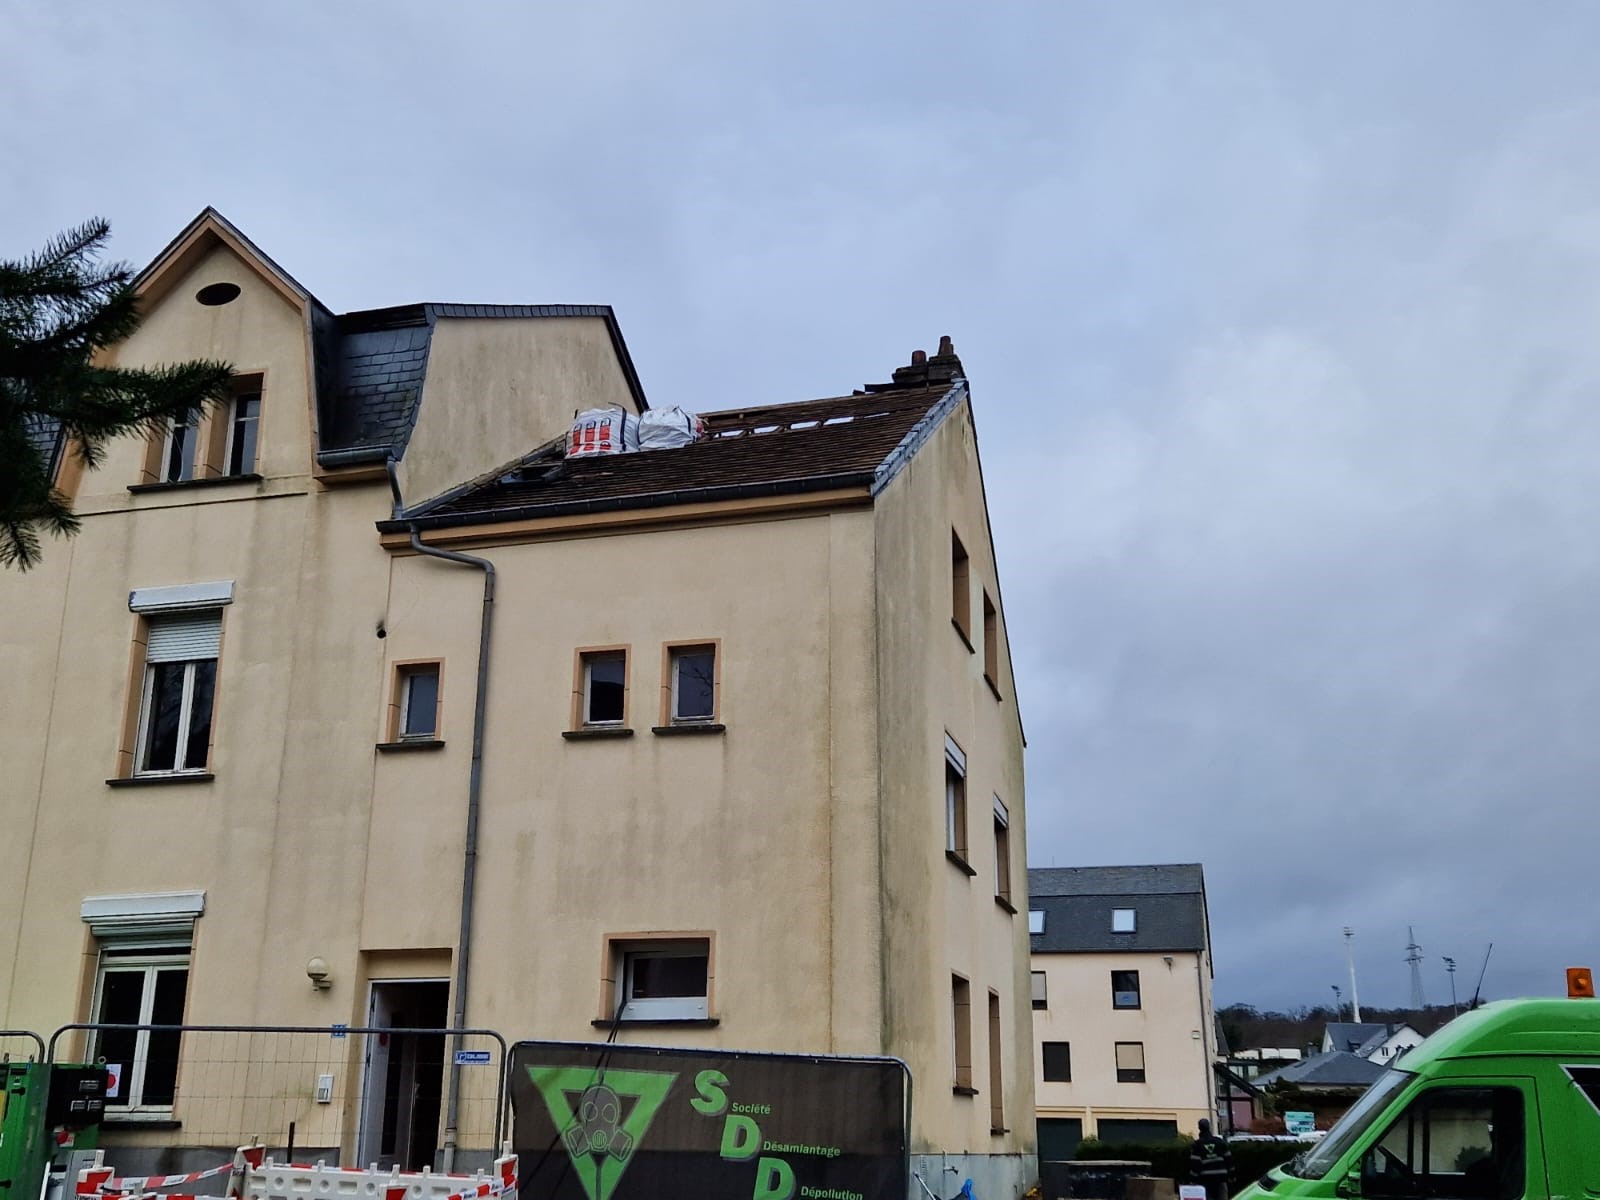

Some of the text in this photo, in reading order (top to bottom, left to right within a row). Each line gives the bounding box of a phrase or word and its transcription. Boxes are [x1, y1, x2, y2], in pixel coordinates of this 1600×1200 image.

[690, 1069, 771, 1116] S Société
[720, 1114, 841, 1162] D Désamiantage
[753, 1157, 863, 1200] D Dépollution
